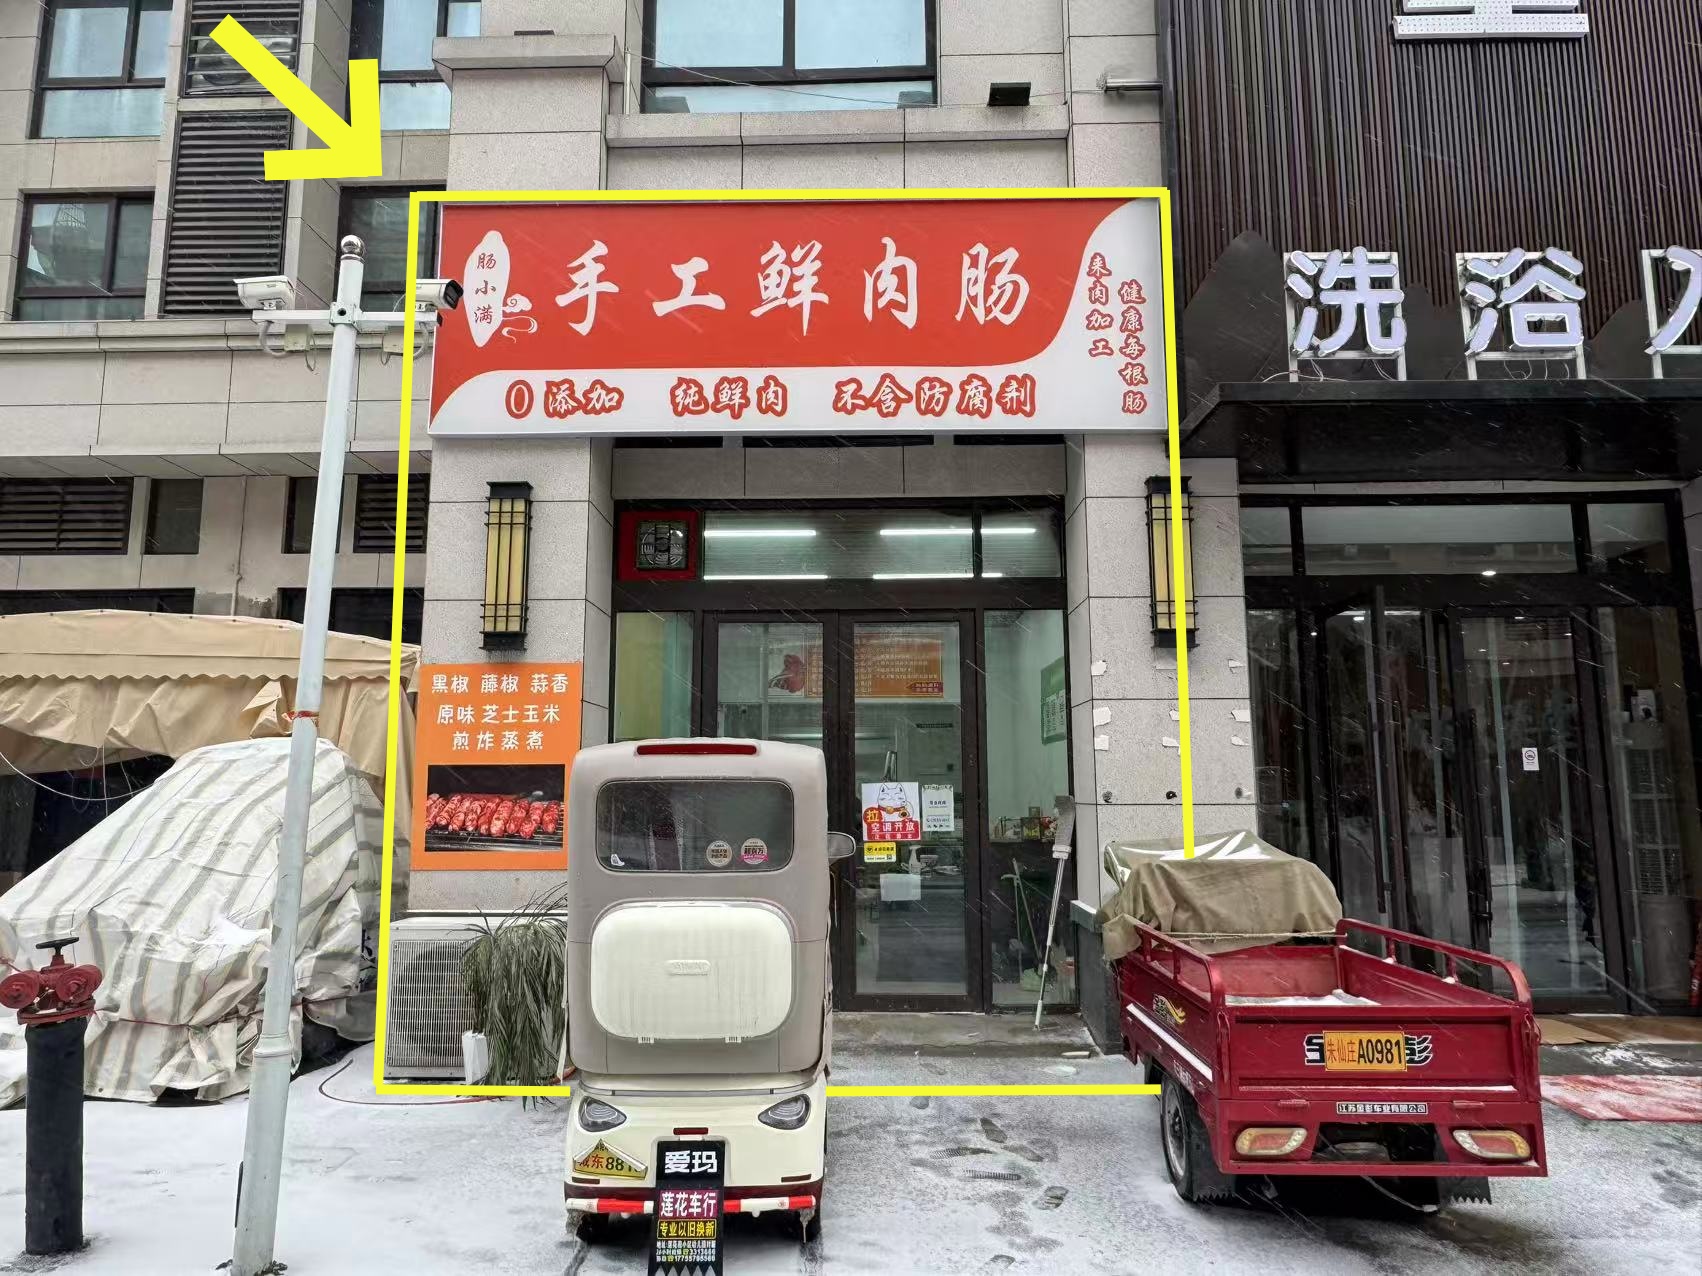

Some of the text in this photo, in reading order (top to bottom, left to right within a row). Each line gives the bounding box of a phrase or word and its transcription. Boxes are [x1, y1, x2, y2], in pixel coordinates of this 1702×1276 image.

[474, 252, 497, 325] 肠小满
[554, 238, 1031, 337] 手工鲜肉肠
[1086, 252, 1114, 358] 来肉加工
[1118, 278, 1149, 414] 健康每根肠
[670, 374, 789, 420] 纯鲜肉
[832, 372, 1037, 419] 不含防腐剂
[431, 673, 569, 694] 黑椒 藤椒 蒜香
[871, 821, 915, 832] 空调开放
[664, 1150, 718, 1174] 爱玛
[660, 1191, 717, 1218] 莲花车行
[660, 1221, 715, 1237] 专业以旧换新
